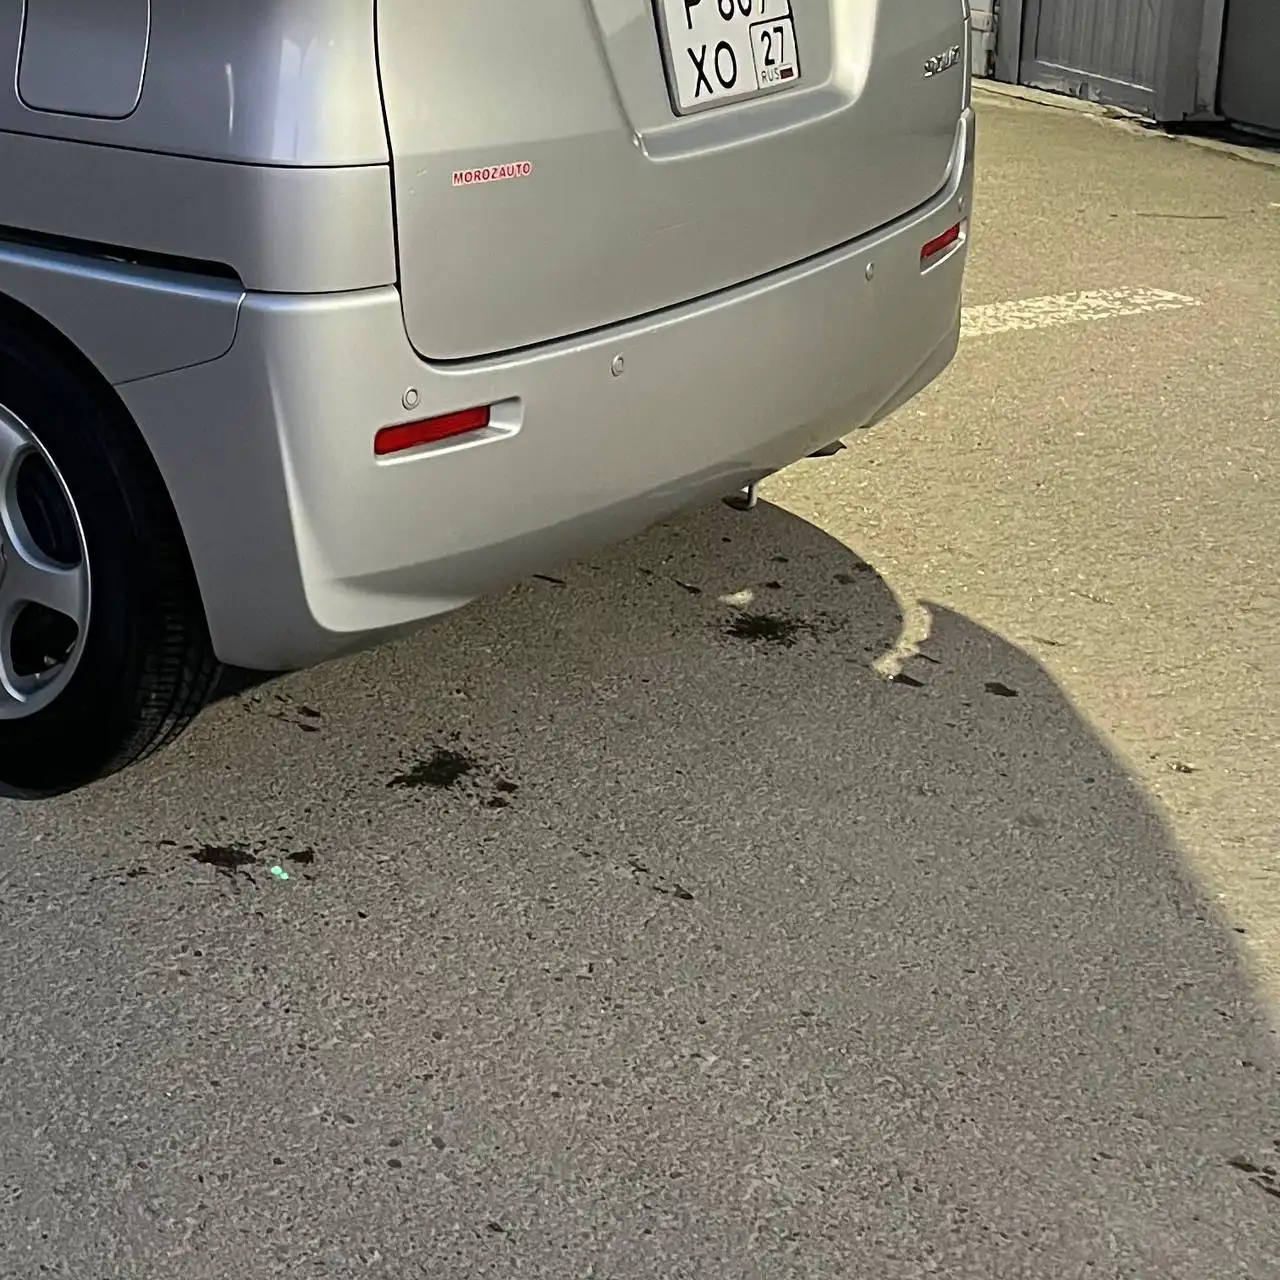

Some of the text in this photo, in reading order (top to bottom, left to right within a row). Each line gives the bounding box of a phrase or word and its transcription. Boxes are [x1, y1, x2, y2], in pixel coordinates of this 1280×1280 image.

[760, 26, 784, 66] 27
[761, 69, 781, 84] RUS
[453, 162, 531, 185] MOROZAUTO
